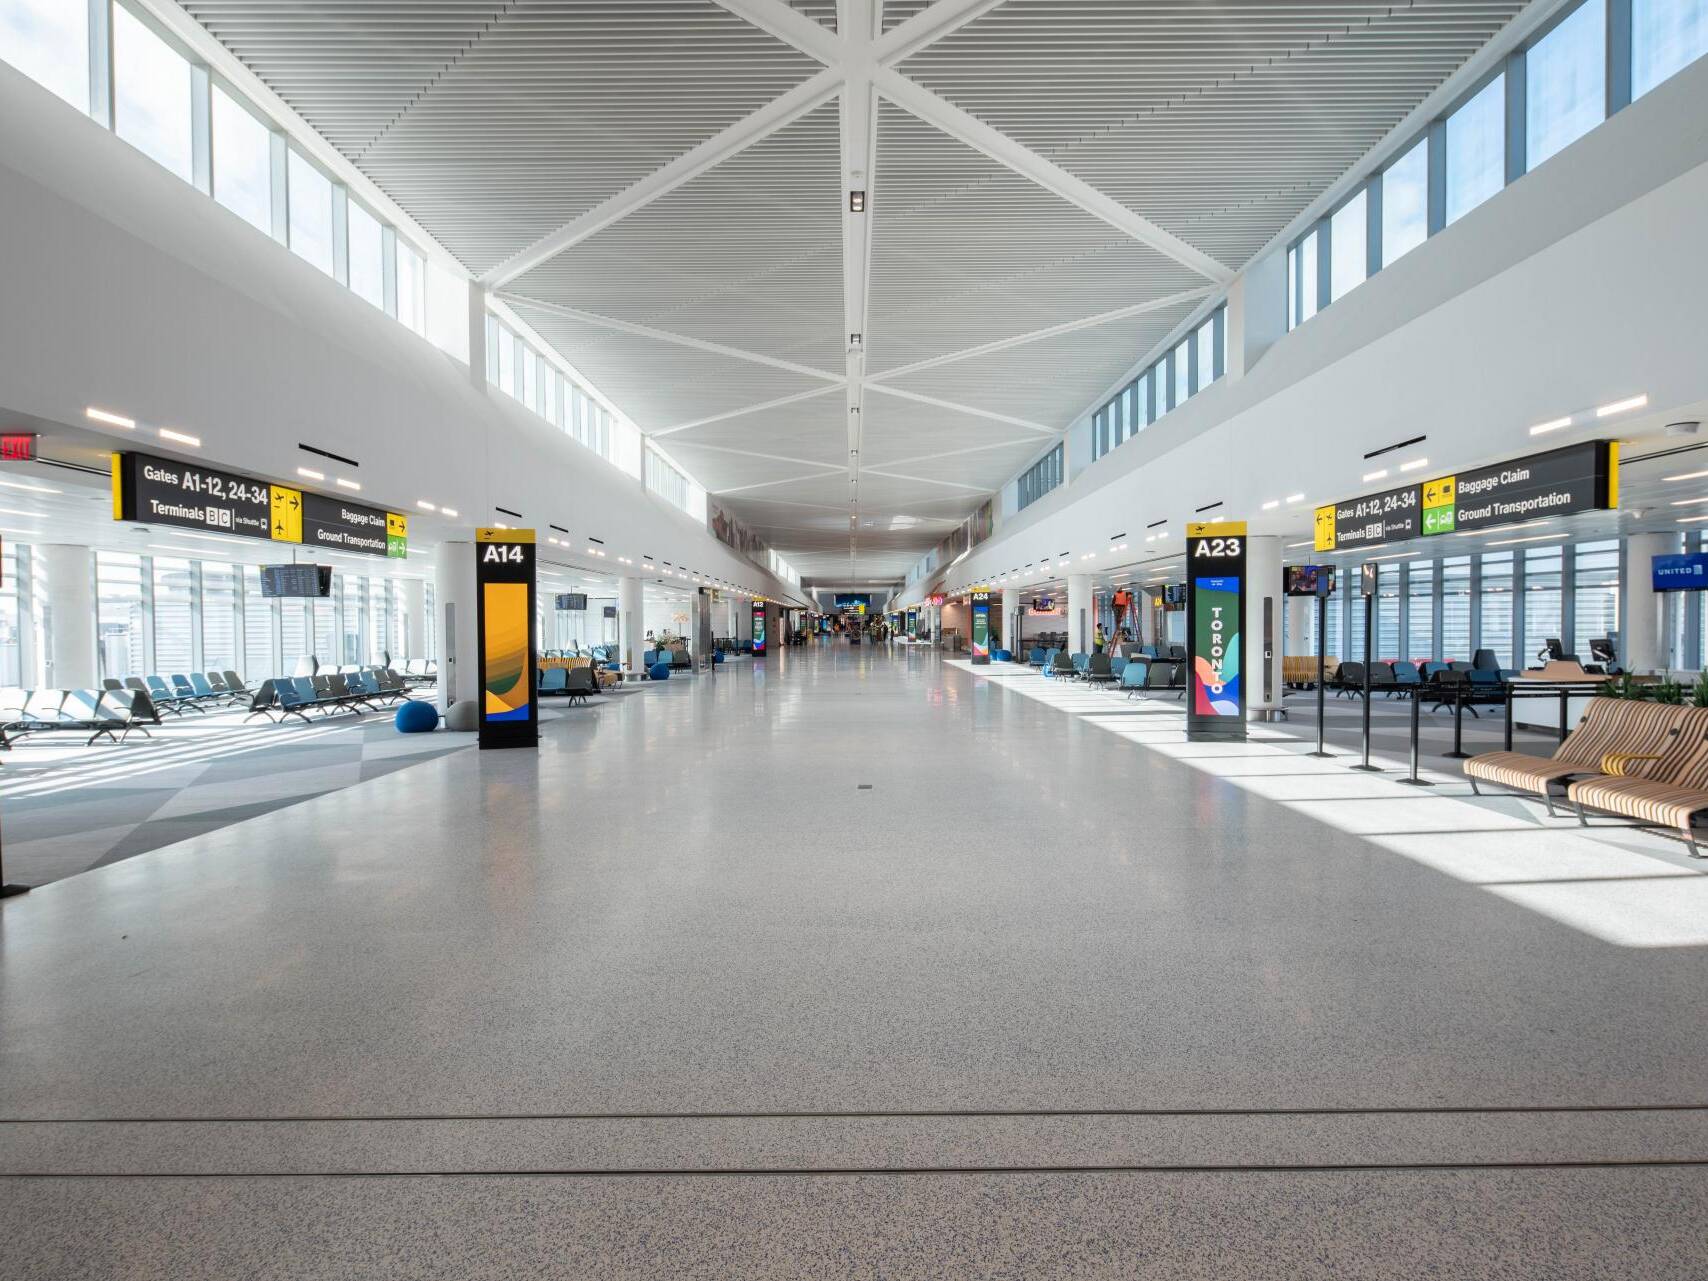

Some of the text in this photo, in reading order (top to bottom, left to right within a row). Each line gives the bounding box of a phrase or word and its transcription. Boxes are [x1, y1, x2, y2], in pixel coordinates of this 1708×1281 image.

[144, 466, 268, 505] Gates A1-12, 24-34
[1458, 468, 1530, 494] Baggage Claim
[150, 500, 205, 520] Terminals
[1337, 491, 1416, 520] Gates A1-12, 24-34
[1458, 492, 1571, 521] Ground Transportation
[341, 508, 386, 527] Baggage Claim
[317, 528, 386, 550] Ground Transportation
[1337, 528, 1366, 541] Terminals
[483, 545, 524, 563] A14
[1194, 538, 1241, 557] A23
[1657, 567, 1692, 576] UNITED
[1210, 607, 1224, 694] TORONTO
